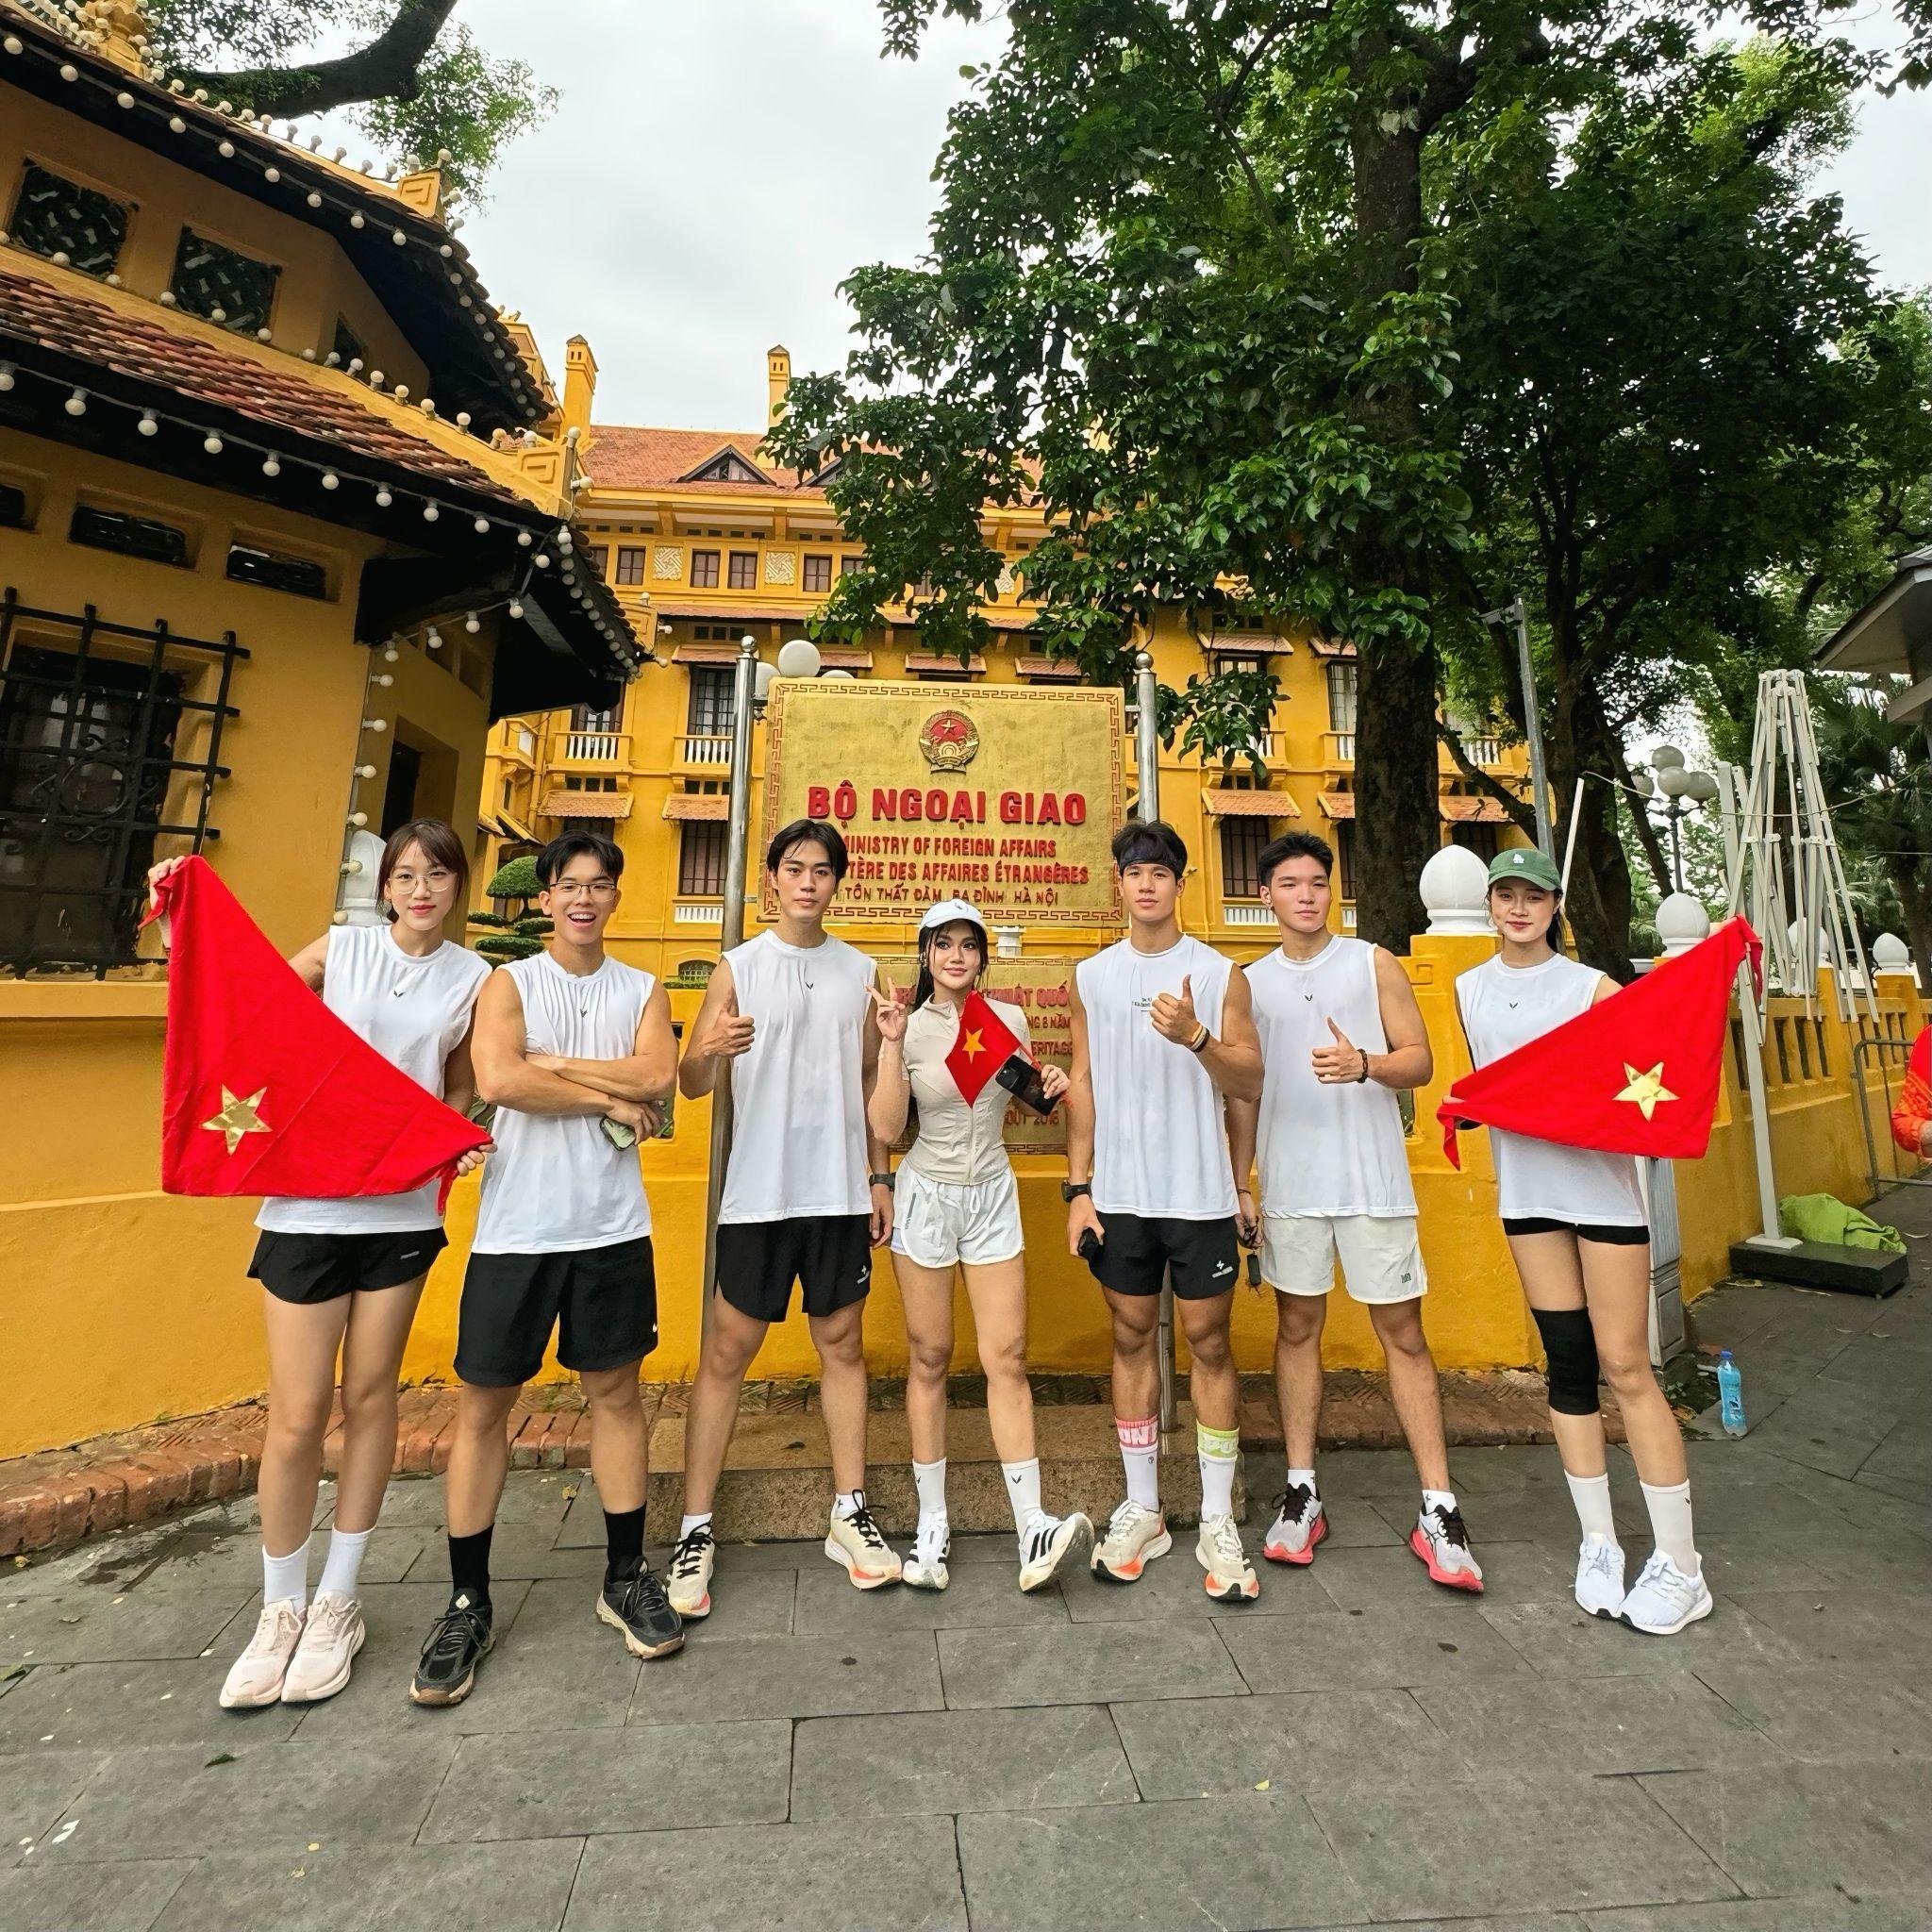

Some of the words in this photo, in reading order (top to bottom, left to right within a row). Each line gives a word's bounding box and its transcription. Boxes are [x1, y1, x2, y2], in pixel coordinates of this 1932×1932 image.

[808, 780, 857, 828] BỘ
[873, 789, 986, 829] NGOẠI
[1000, 791, 1086, 825] GIAO
[913, 837, 931, 856] OF
[934, 837, 994, 858] FOREIGN
[999, 839, 1057, 858] AFFAIRS
[889, 861, 917, 881] DES
[923, 862, 990, 882] AFFAIRES
[845, 883, 872, 902] TÔN
[1014, 886, 1031, 904] HÀ
[1036, 888, 1058, 907] NỘI
